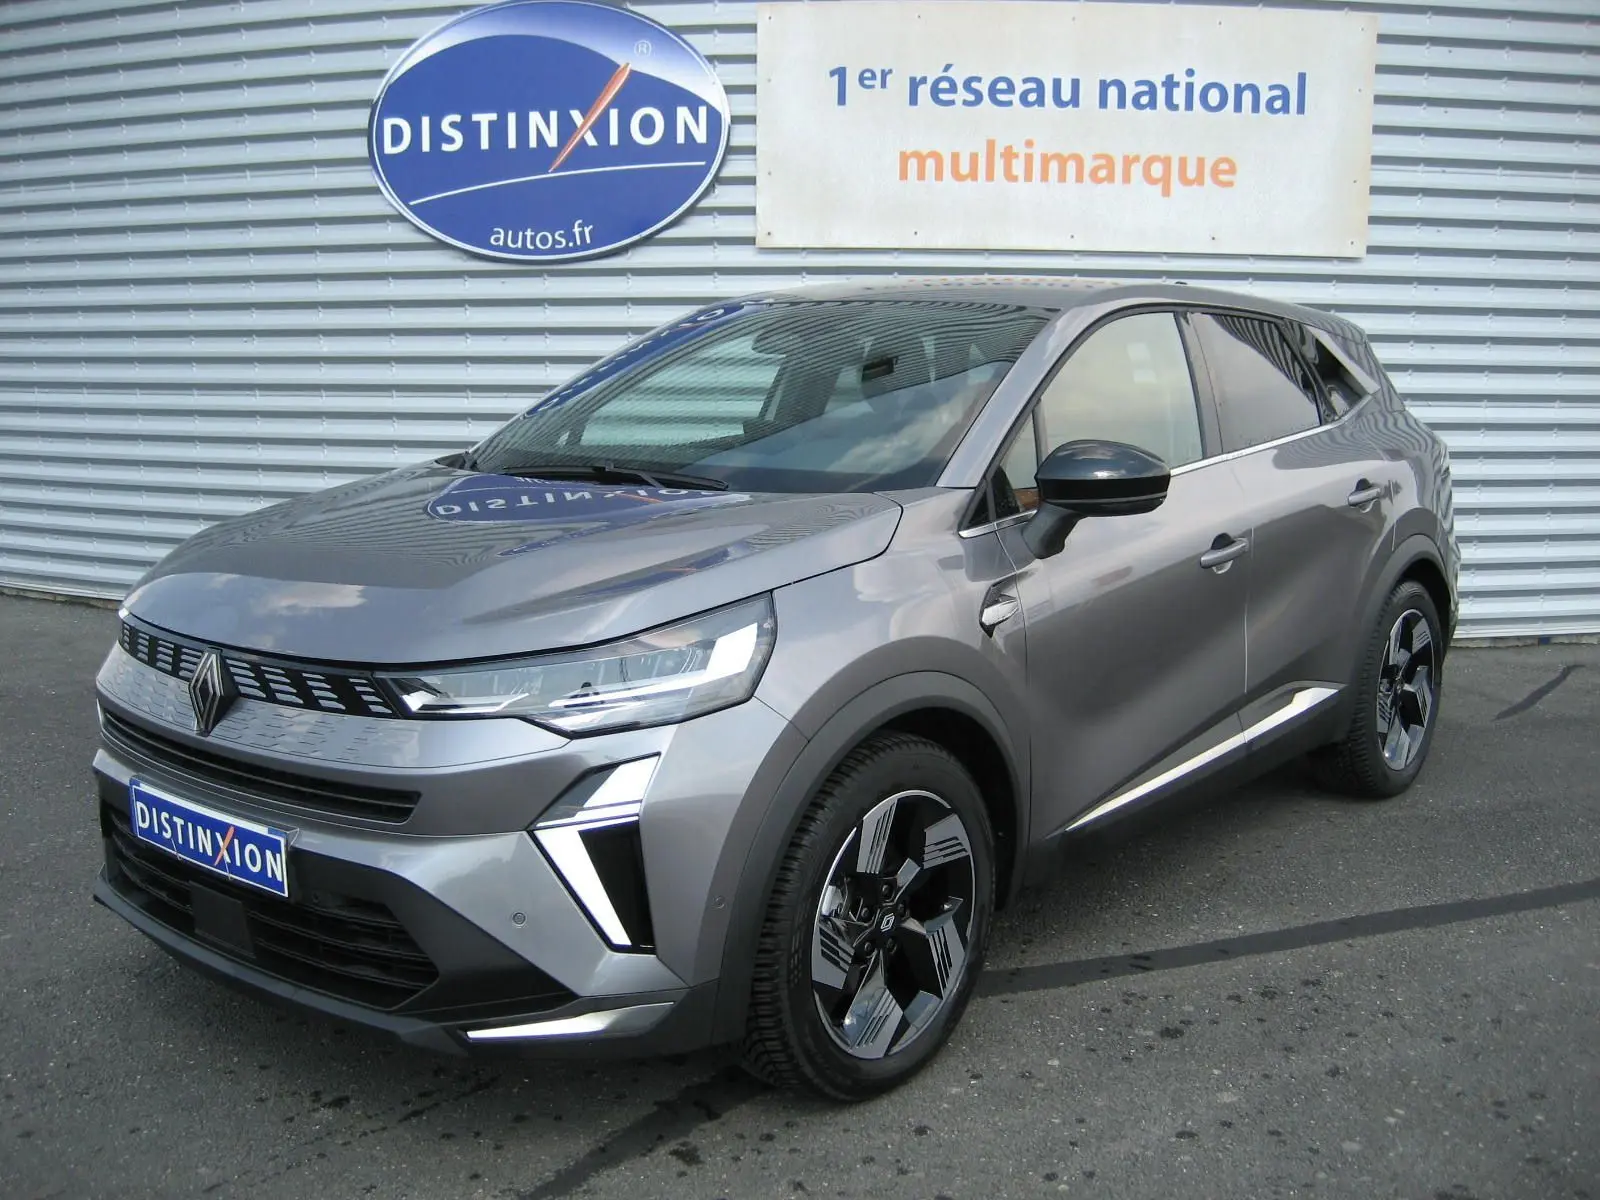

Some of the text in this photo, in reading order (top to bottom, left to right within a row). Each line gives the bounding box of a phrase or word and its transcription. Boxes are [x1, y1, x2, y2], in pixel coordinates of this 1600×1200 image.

[829, 63, 1308, 116] 1er réseau national
[898, 139, 1238, 197] multimarque
[490, 219, 593, 249] autos.fr
[135, 801, 283, 882] DISTINXION
